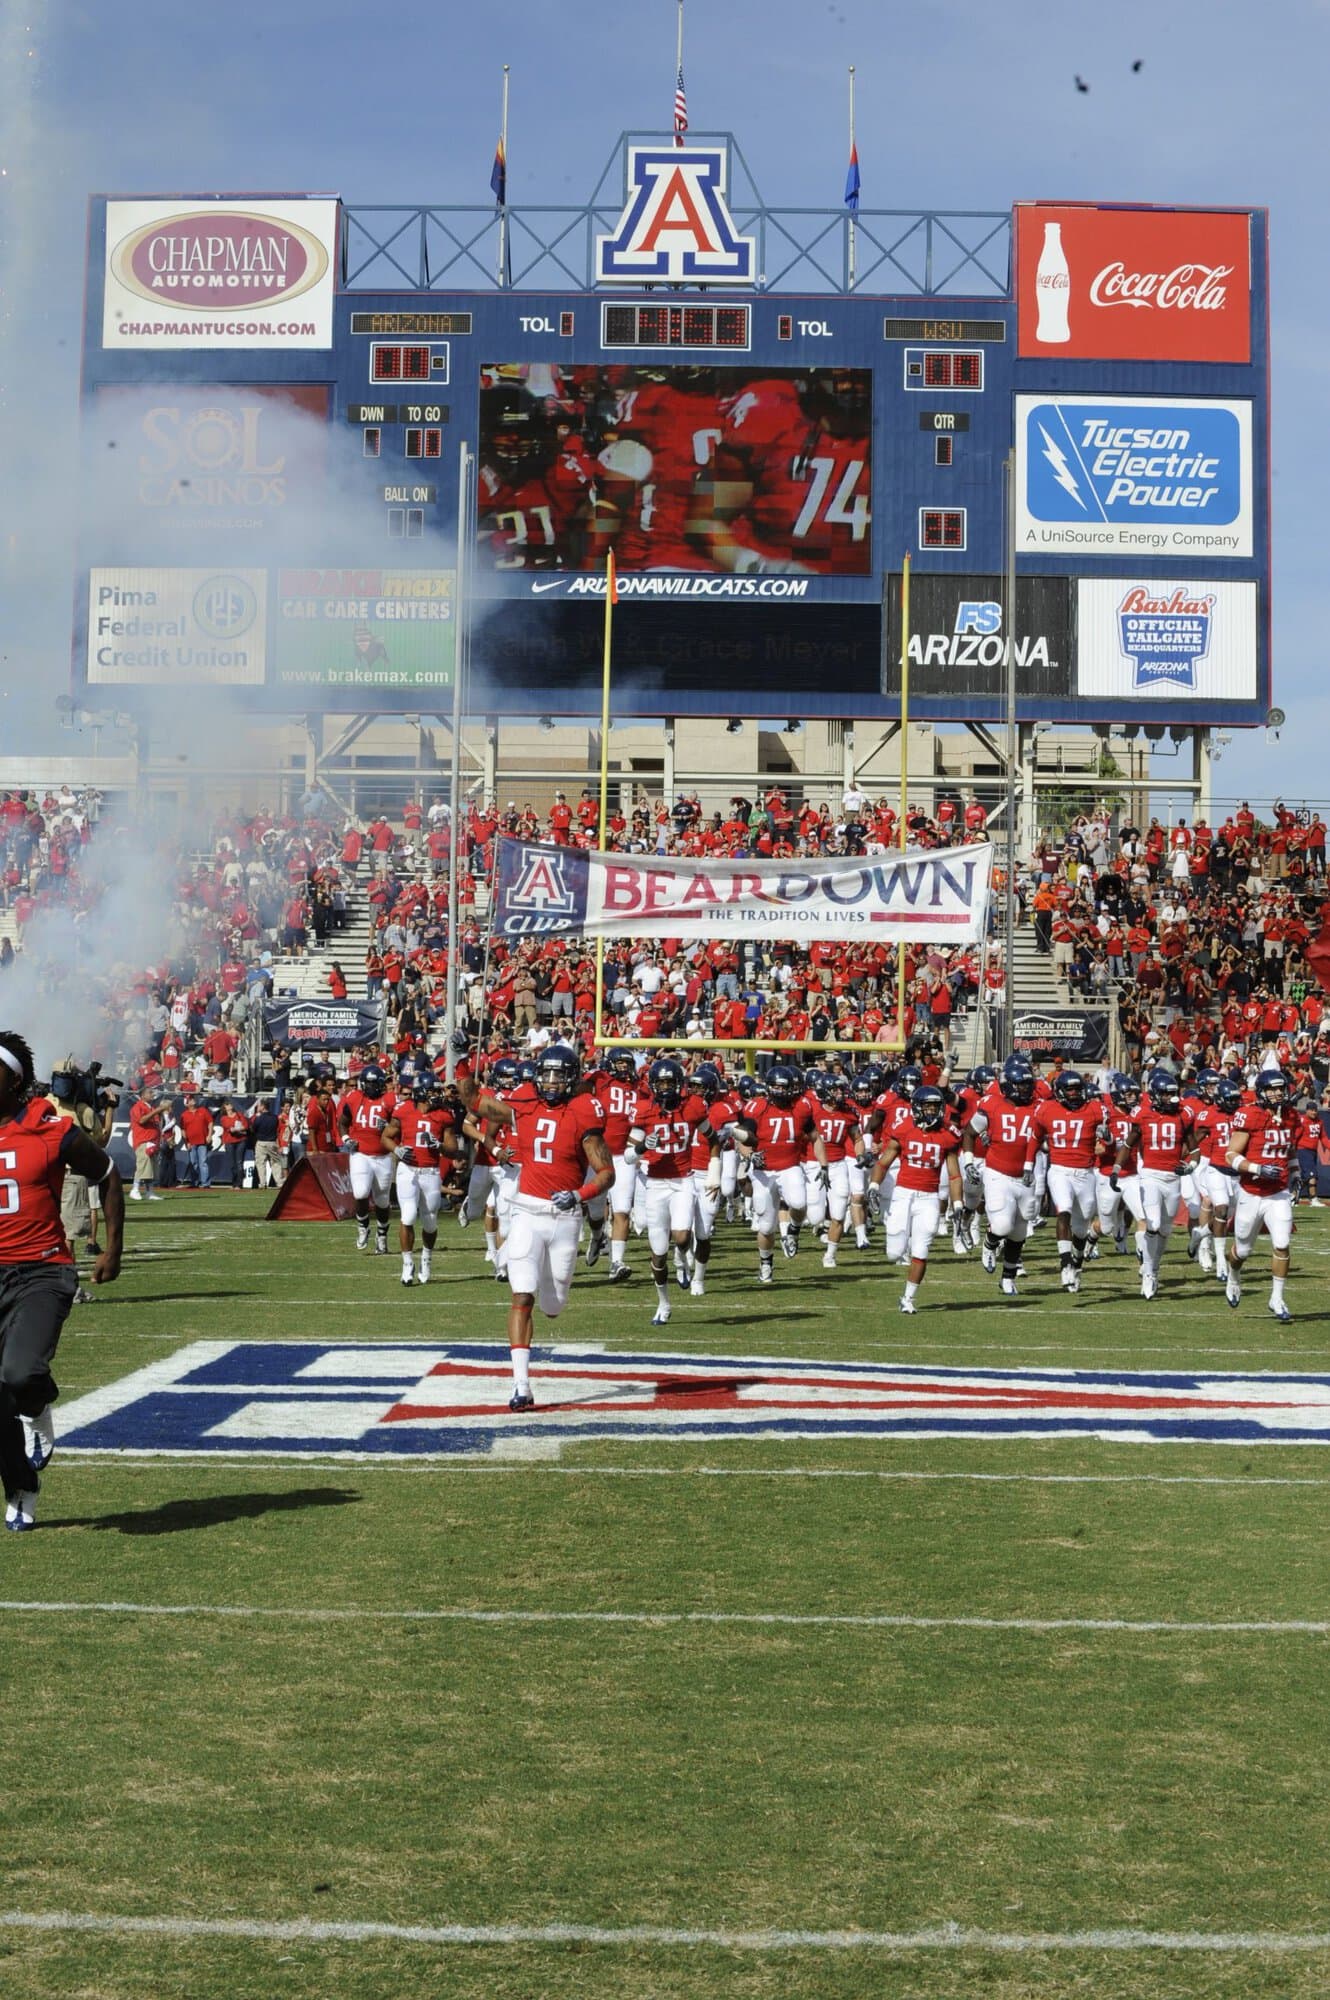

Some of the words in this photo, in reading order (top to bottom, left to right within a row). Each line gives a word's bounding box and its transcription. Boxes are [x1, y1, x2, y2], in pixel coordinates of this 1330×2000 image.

[596, 146, 756, 282] A
[148, 235, 291, 273] CHAPMAN
[152, 274, 286, 288] AUTOMOTIVE
[1089, 262, 1234, 309] Coca-Cola
[118, 322, 317, 336] CHAPMANTUCSON.COM
[371, 314, 452, 333] ARIZONA
[519, 316, 555, 333] TOL
[639, 308, 747, 345] 4:53
[797, 321, 833, 337] TOL
[924, 321, 963, 340] WSU
[360, 406, 385, 422] DWN
[408, 406, 422, 421] TO
[425, 406, 441, 422] GO
[933, 413, 956, 430] QTR
[139, 407, 286, 474] SOL
[1081, 419, 1190, 450] Tucson
[1092, 448, 1220, 479] Electric
[139, 478, 287, 506] CASINOS
[384, 487, 409, 502] BALL
[412, 487, 428, 502] ON
[1105, 478, 1219, 508] Power
[1026, 530, 1037, 542] A
[1041, 530, 1114, 543] UniSource
[1119, 531, 1168, 547] Energy
[1172, 532, 1239, 548] Company
[98, 586, 157, 606] Pima
[282, 600, 318, 620] CAR
[325, 600, 369, 620] CARE
[375, 600, 451, 620] CENTERS
[953, 600, 1003, 635] FS
[98, 616, 186, 637] Federal
[1127, 619, 1203, 631] OFFICIAL
[1127, 632, 1202, 644] TAILGATE
[1127, 644, 1202, 653] HEADQUARTERS
[97, 646, 171, 667] Credit
[176, 647, 248, 667] Union
[898, 634, 1050, 668] ARIZONA
[281, 668, 449, 684] www.brakemax.com
[1140, 662, 1190, 671] ARIZONA
[503, 914, 573, 934] CLUB
[708, 909, 734, 921] THE
[739, 909, 820, 921] TRADITION
[826, 911, 865, 922] LIVES
[289, 1011, 328, 1019] AMERICAN
[330, 1011, 358, 1019] FAMILY
[1015, 1022, 1055, 1030] AMERICAN
[609, 1086, 638, 1115] 92
[355, 1104, 382, 1129] 46
[768, 1116, 796, 1144] 71
[819, 1119, 846, 1144] 37
[1001, 1113, 1033, 1143] 54
[1052, 1119, 1084, 1148] 27
[1148, 1122, 1177, 1151] 19
[533, 1117, 557, 1164] 2
[1261, 1129, 1292, 1159] 25
[907, 1140, 941, 1169] 23
